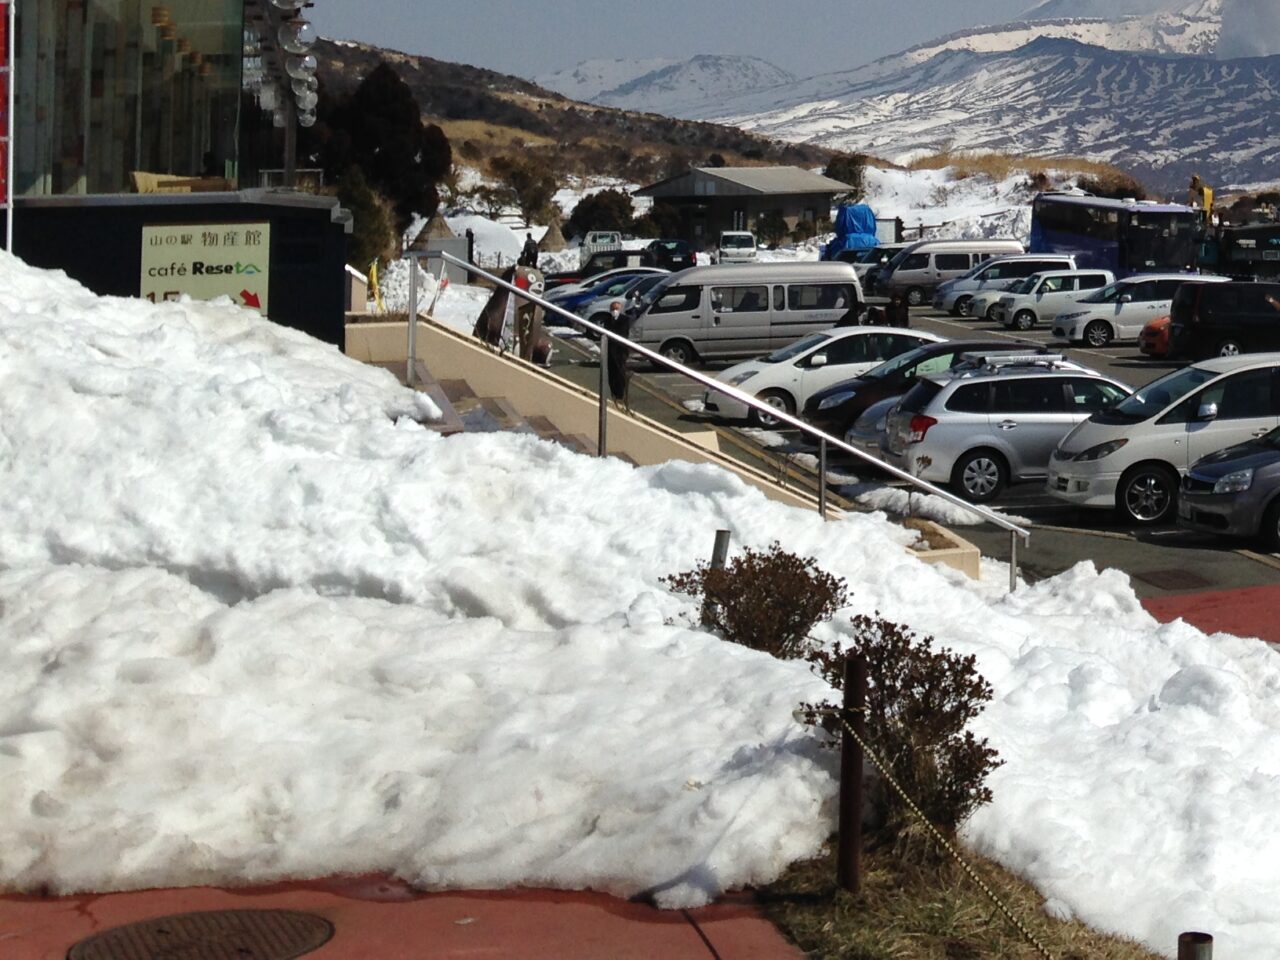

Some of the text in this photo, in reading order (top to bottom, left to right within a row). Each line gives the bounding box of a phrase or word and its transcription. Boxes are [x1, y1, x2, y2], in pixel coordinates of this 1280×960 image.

[201, 230, 262, 247] 物産館
[148, 262, 187, 277] café
